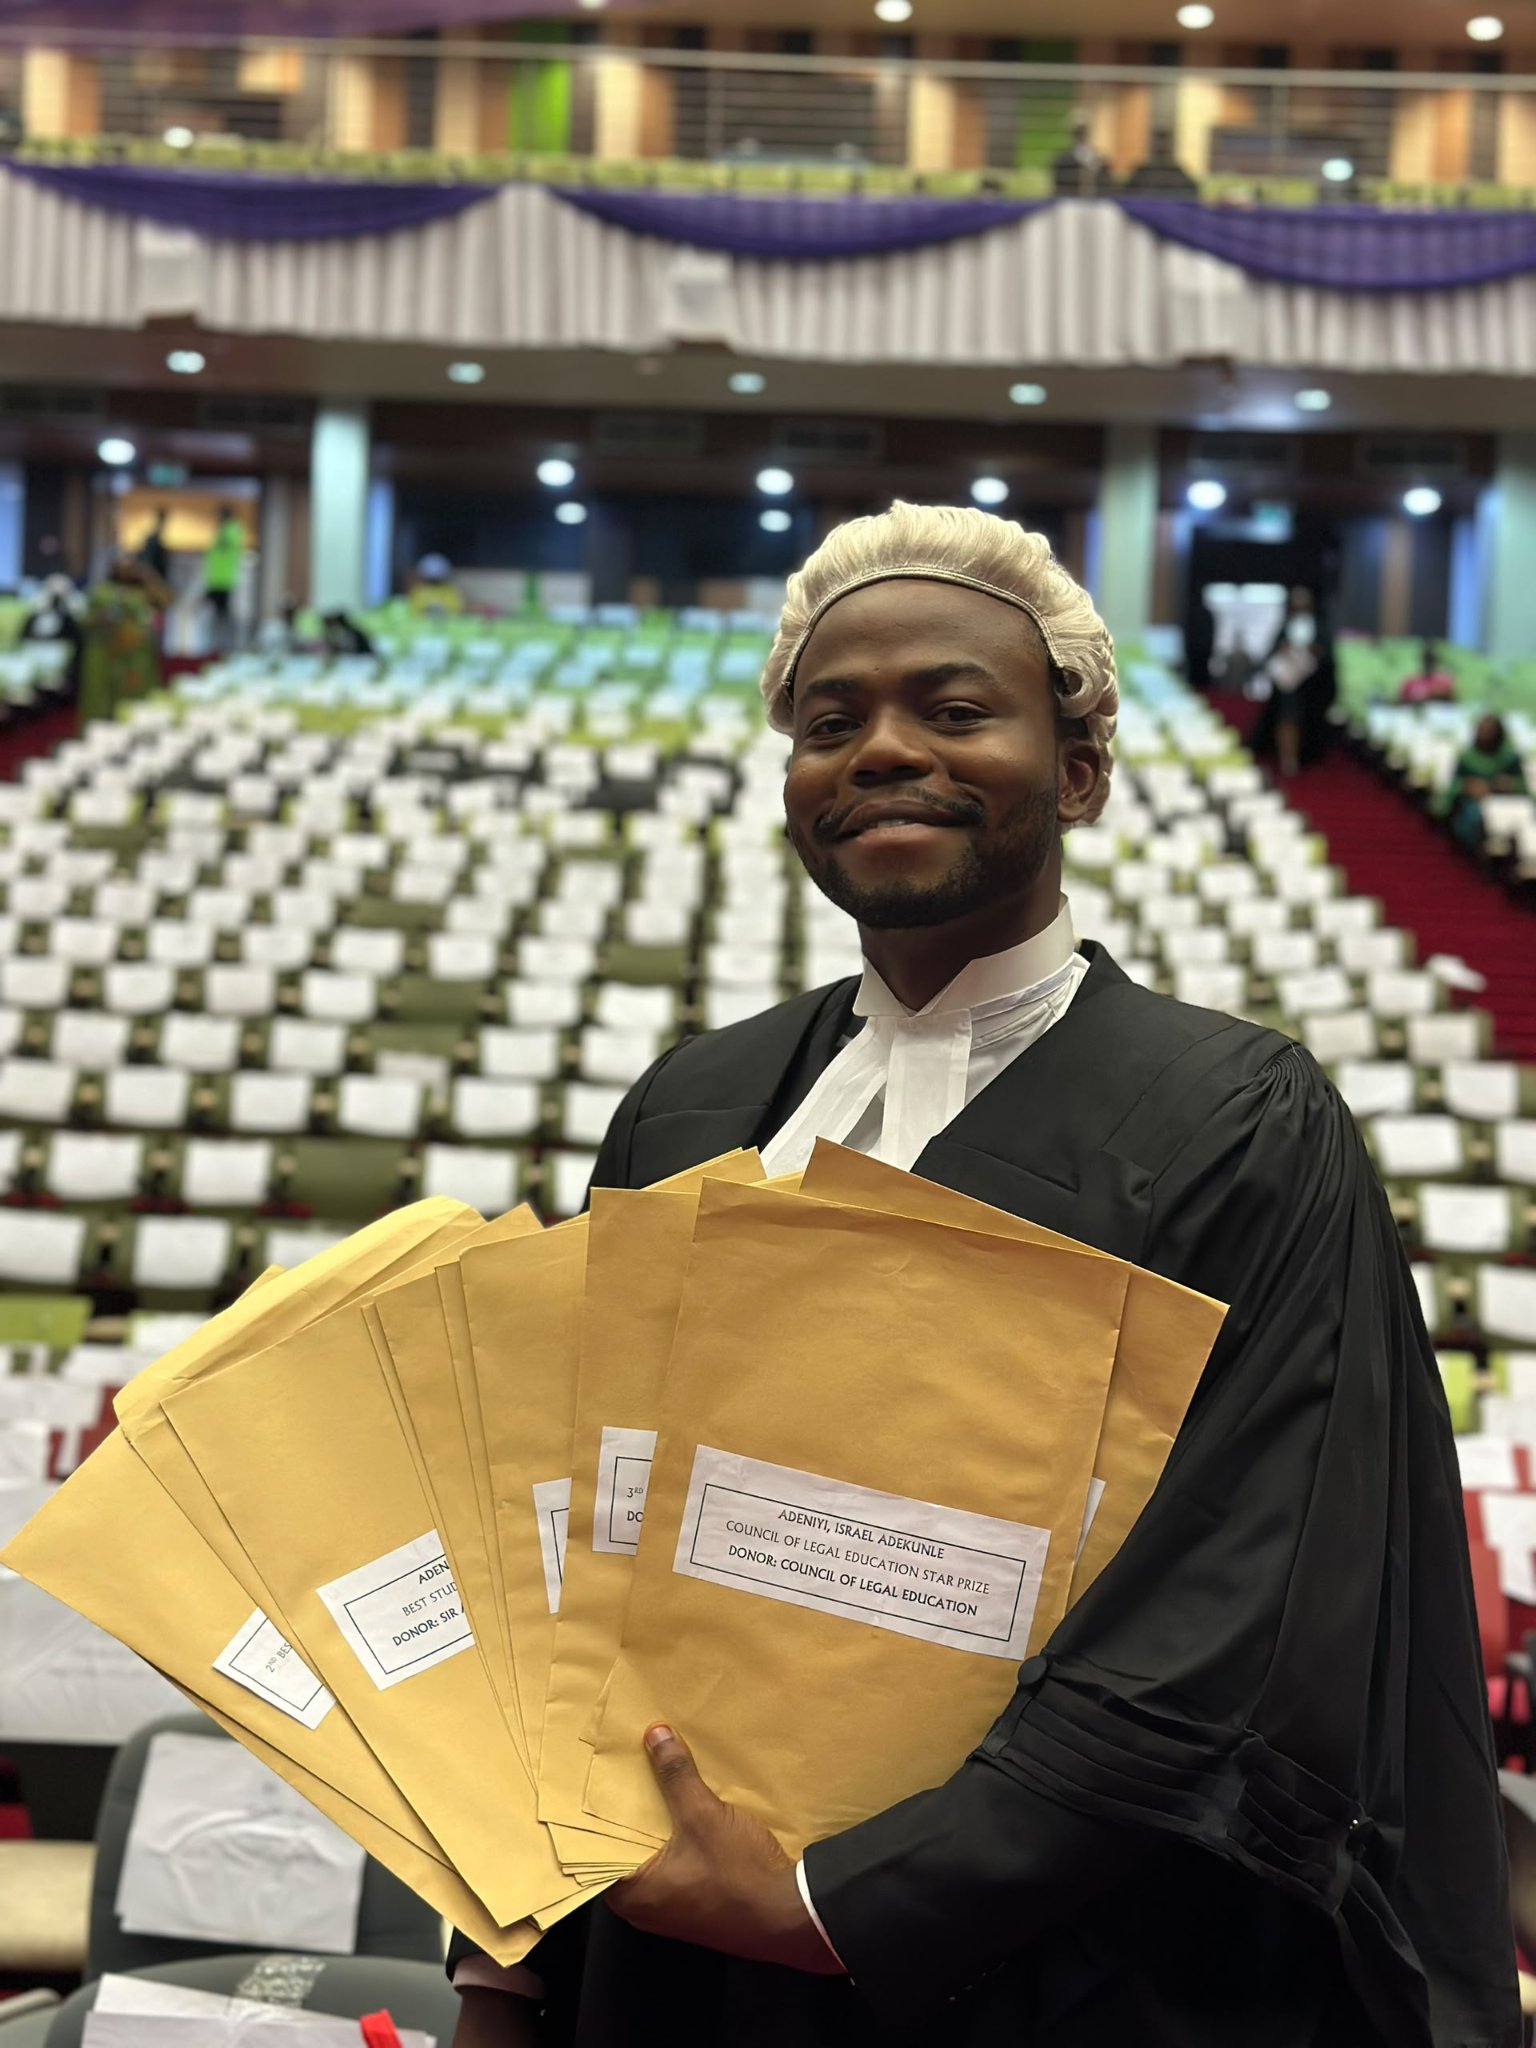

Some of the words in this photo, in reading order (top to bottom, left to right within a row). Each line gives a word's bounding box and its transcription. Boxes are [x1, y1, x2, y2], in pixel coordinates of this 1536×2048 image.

[626, 1486, 644, 1498] 3RD
[778, 1509, 831, 1533] ADENIYI,
[834, 1522, 874, 1542] ISRAEL
[877, 1534, 945, 1559] ADEKUNLE
[418, 1560, 450, 1584] ADEN
[726, 1520, 780, 1543] COUNCIL
[784, 1535, 801, 1547] OF
[804, 1540, 841, 1559] LEGAL
[845, 1550, 919, 1578] EDUCATION
[922, 1569, 954, 1586] STAR
[957, 1577, 990, 1594] PRIZE
[728, 1545, 777, 1567] DONOR:
[781, 1558, 836, 1582] COUNCIL
[839, 1574, 857, 1587] OF
[860, 1580, 898, 1598] LEGAL
[902, 1589, 978, 1616] EDUCATION
[401, 1597, 428, 1616] BEST
[392, 1619, 439, 1646] DONOR:
[440, 1607, 459, 1623] SIR
[265, 1656, 277, 1673] 2ND
